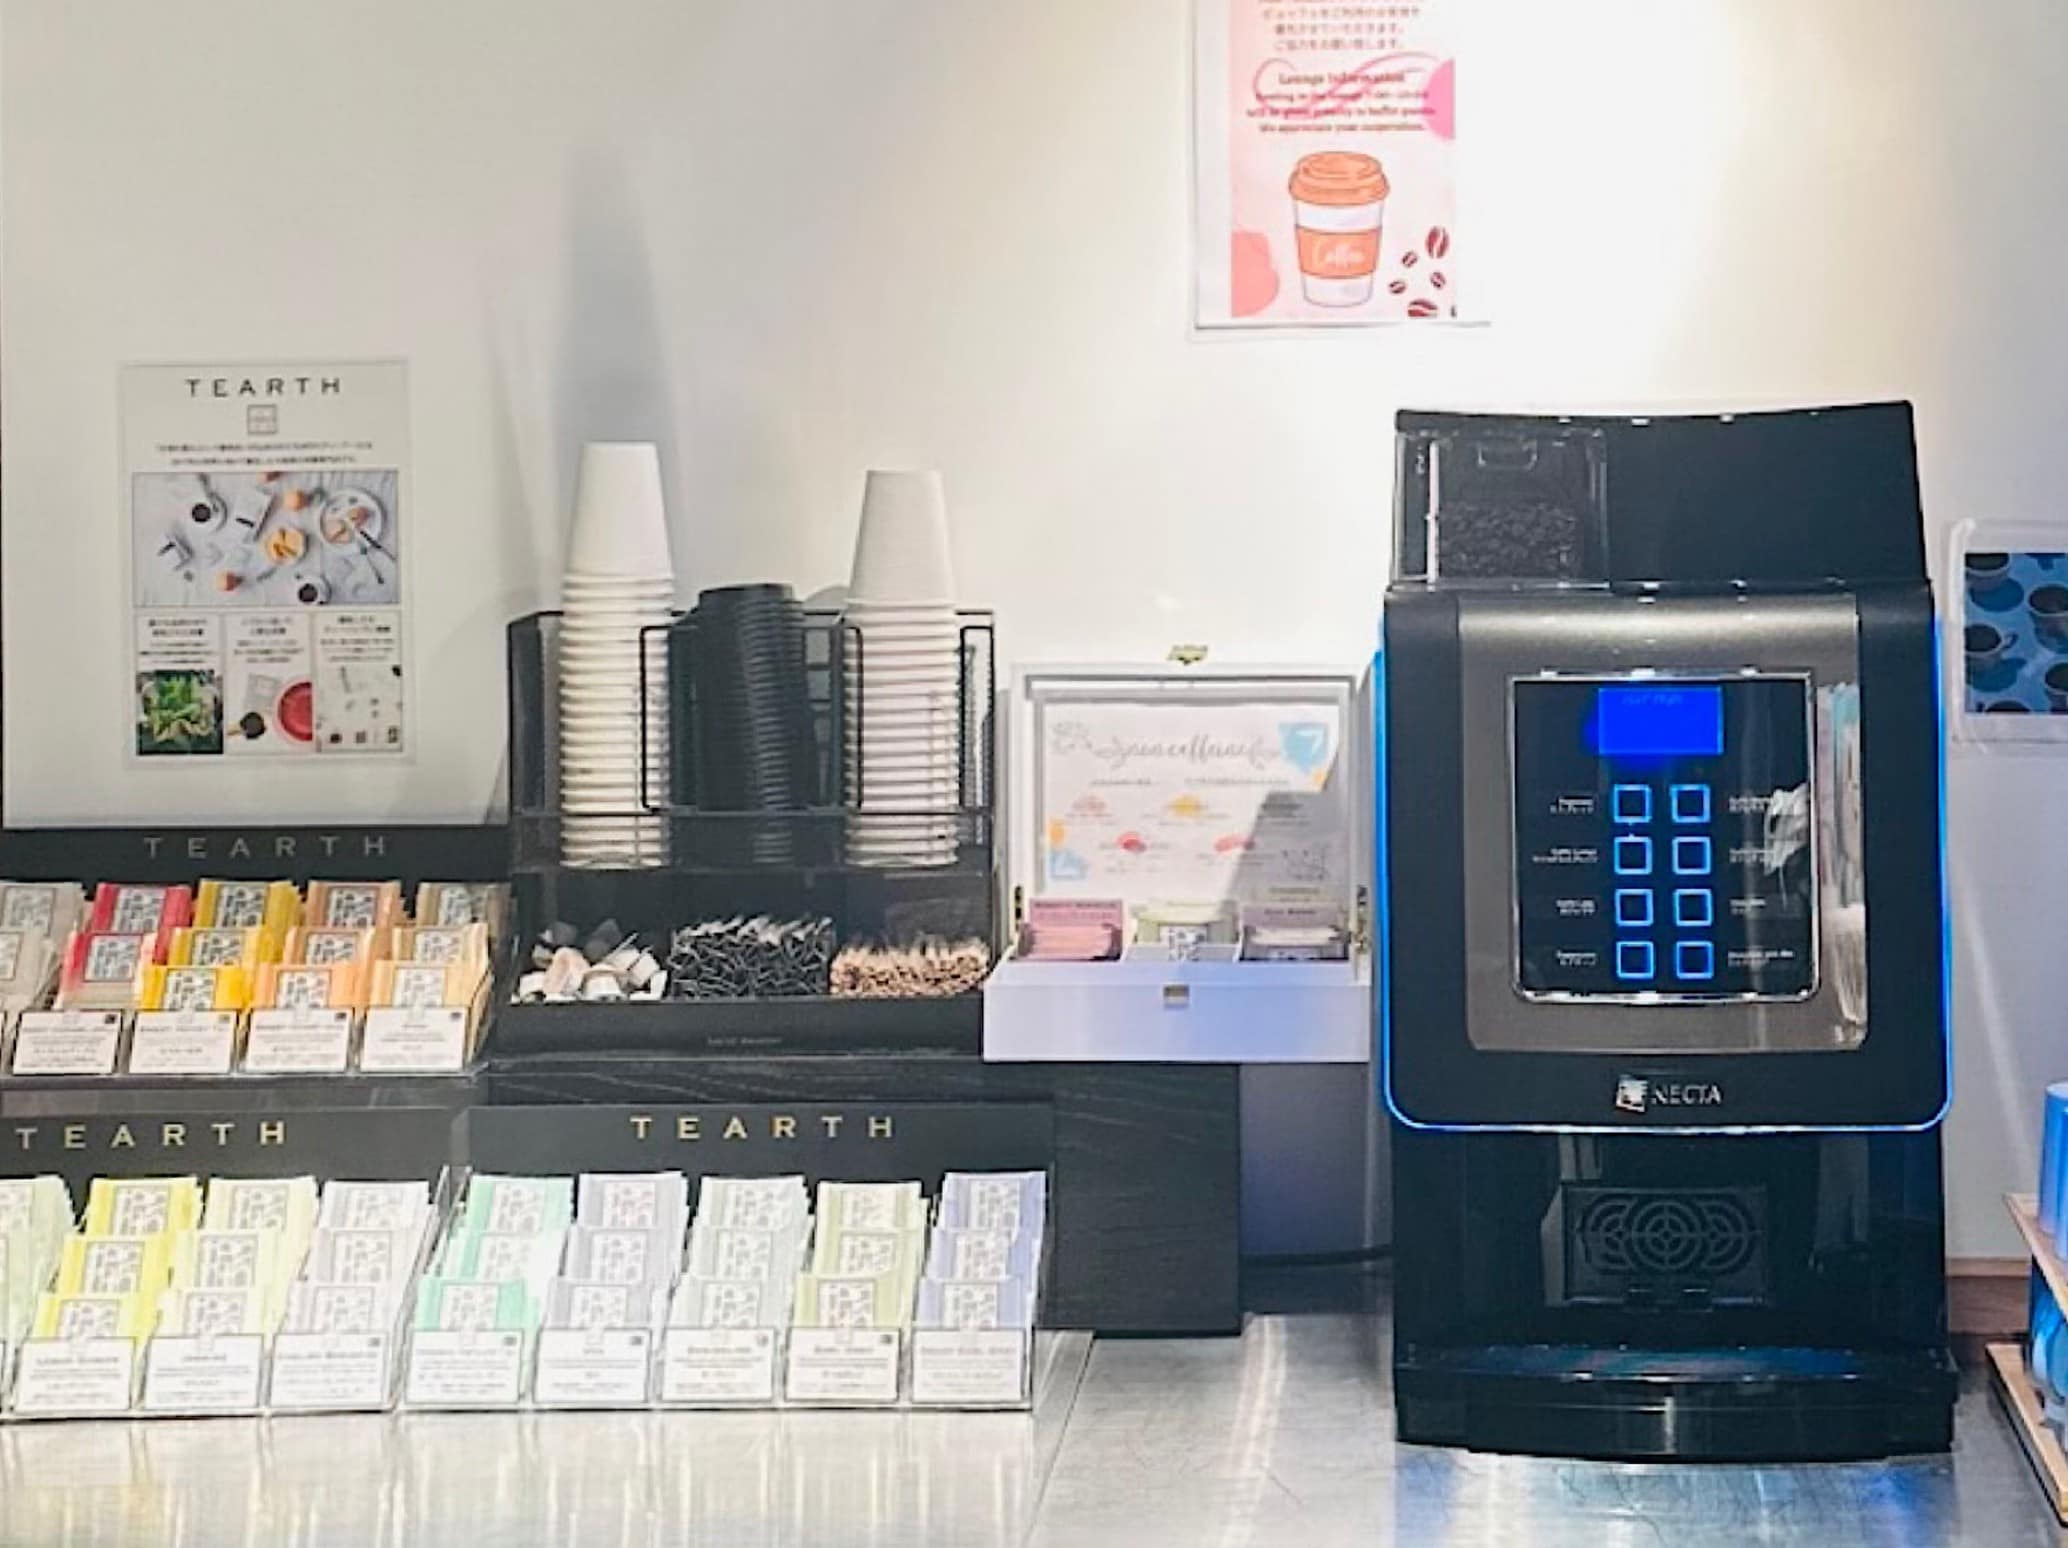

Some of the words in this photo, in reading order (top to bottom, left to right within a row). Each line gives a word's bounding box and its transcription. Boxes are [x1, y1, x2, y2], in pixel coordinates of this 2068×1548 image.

[185, 378, 341, 398] TEARTH
[143, 835, 386, 860] TEARTH
[1650, 1083, 1721, 1105] NECTA
[15, 1120, 286, 1151] TEARTH
[630, 1116, 894, 1140] TEARTH
